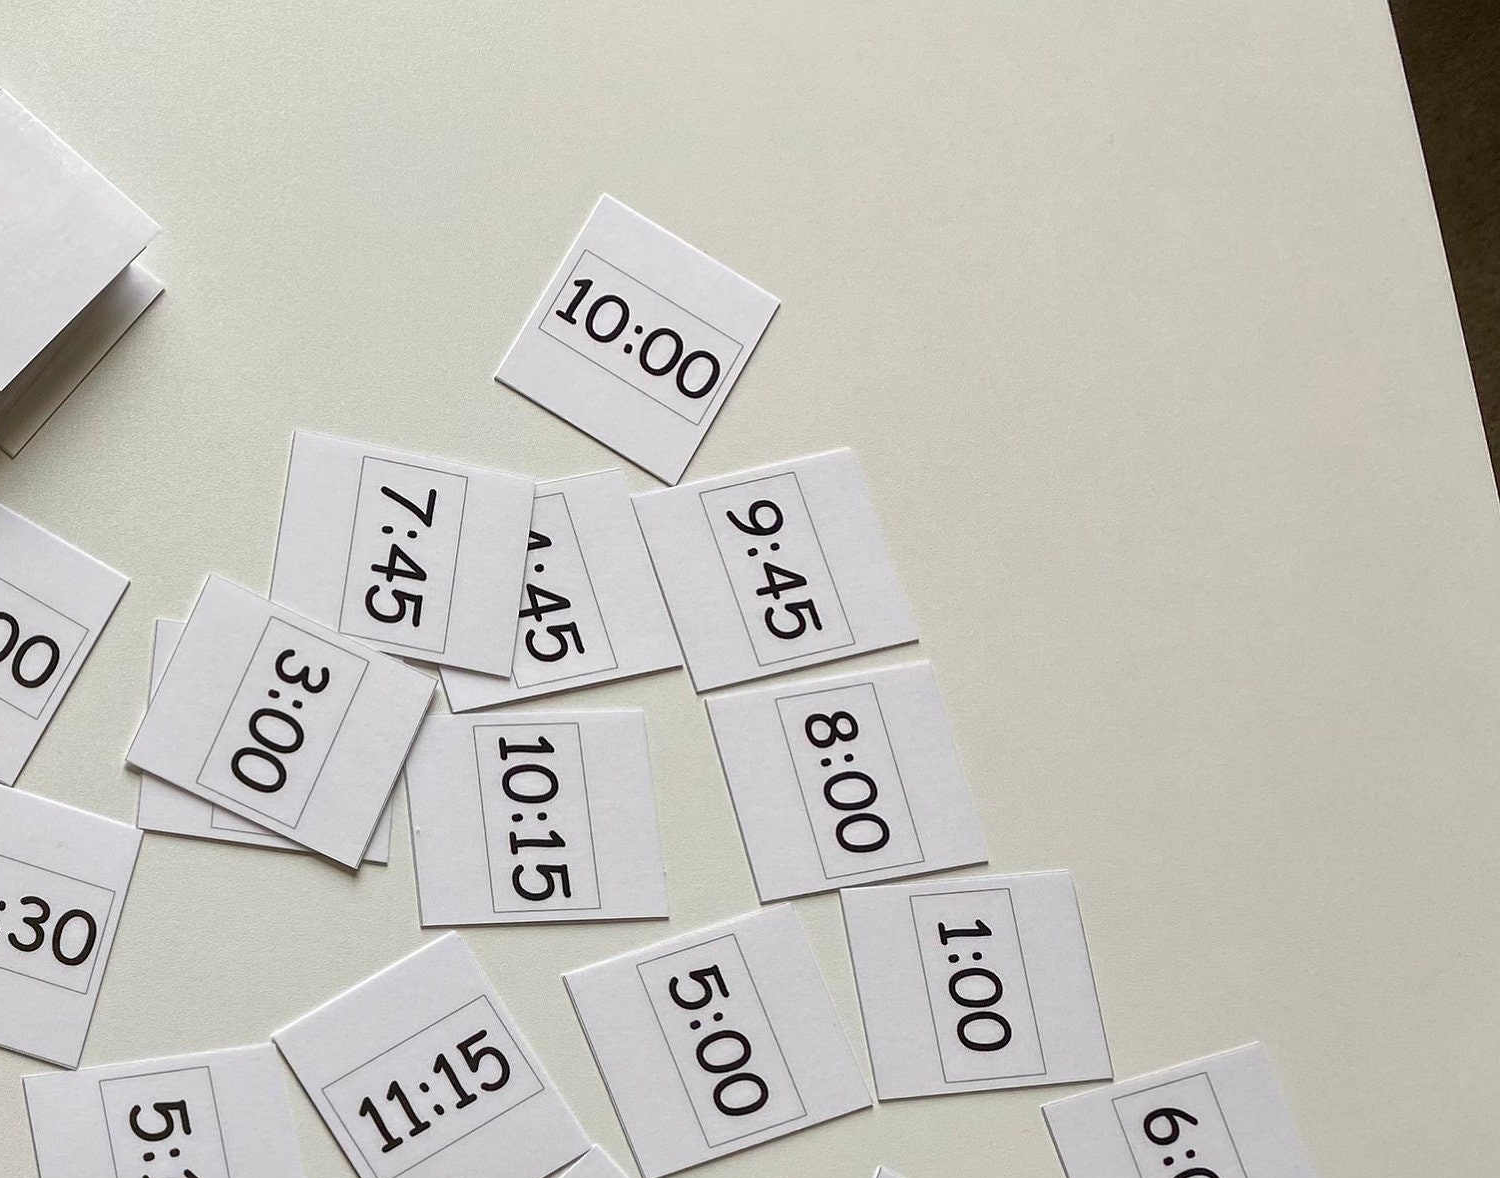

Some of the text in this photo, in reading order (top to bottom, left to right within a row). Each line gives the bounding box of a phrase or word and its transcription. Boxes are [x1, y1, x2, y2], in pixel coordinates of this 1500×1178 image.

[556, 279, 720, 399] 10:00
[365, 486, 436, 627] 7:45
[727, 500, 822, 639] 9:45
[231, 649, 329, 793] 3:00
[805, 711, 890, 853] 8:00
[499, 736, 571, 901] 10:15
[669, 965, 768, 1116] 5:00
[938, 920, 1011, 1051] 1:00
[359, 1030, 510, 1153] 11:15
